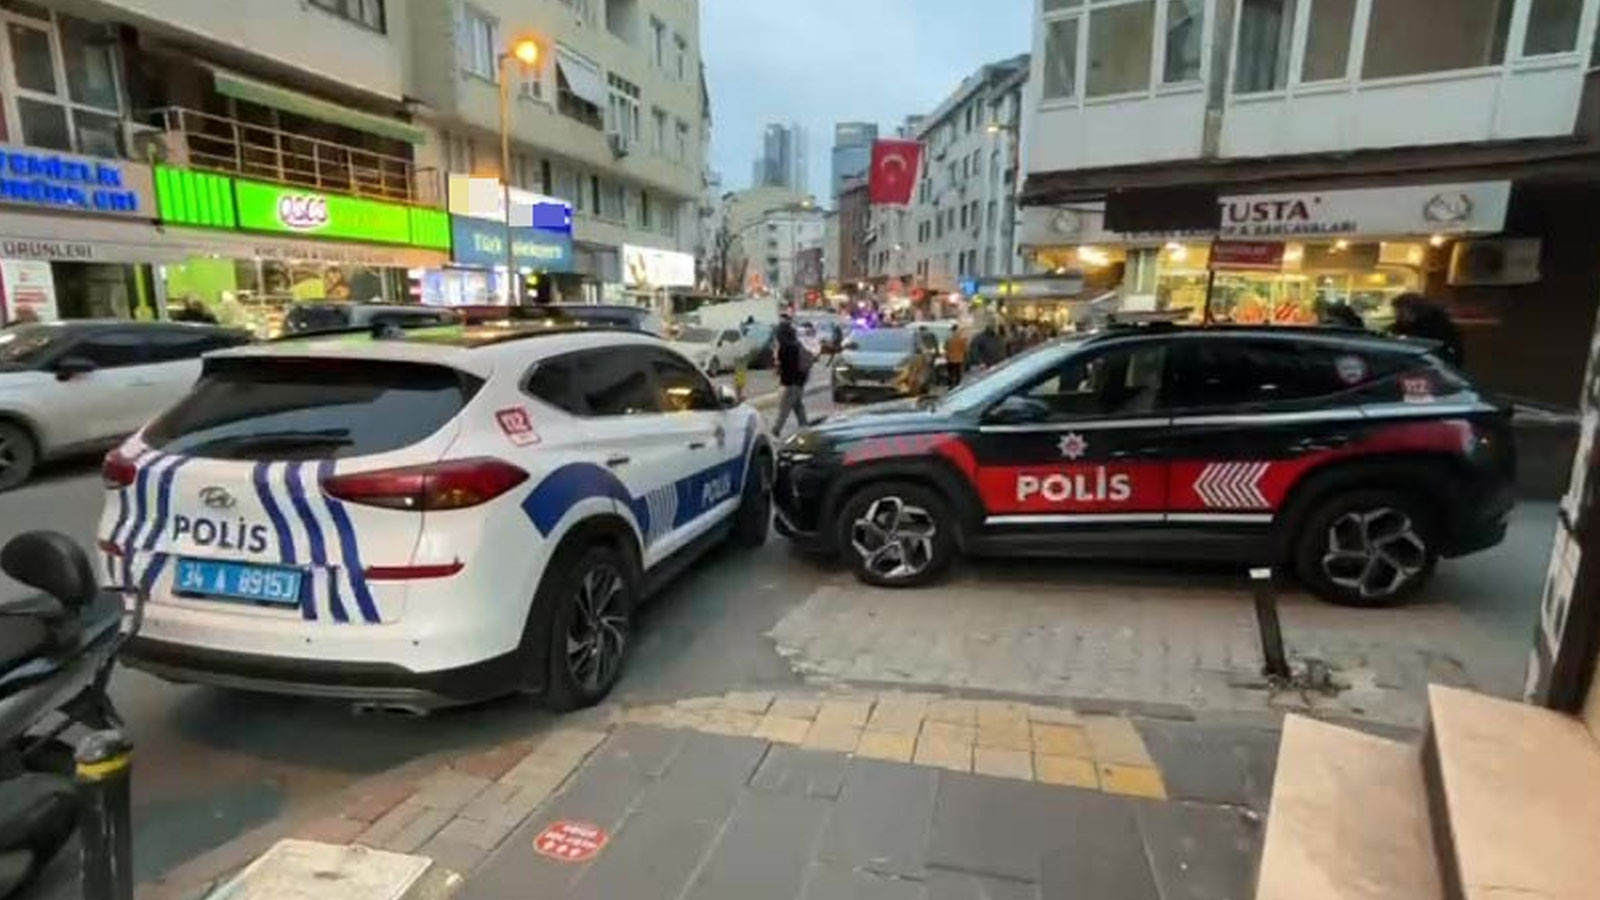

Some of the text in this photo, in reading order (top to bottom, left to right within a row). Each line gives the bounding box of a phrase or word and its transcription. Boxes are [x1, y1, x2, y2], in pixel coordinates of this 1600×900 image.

[1017, 465, 1131, 501] POLİS
[172, 513, 268, 554] POLİS
[214, 567, 227, 591] A
